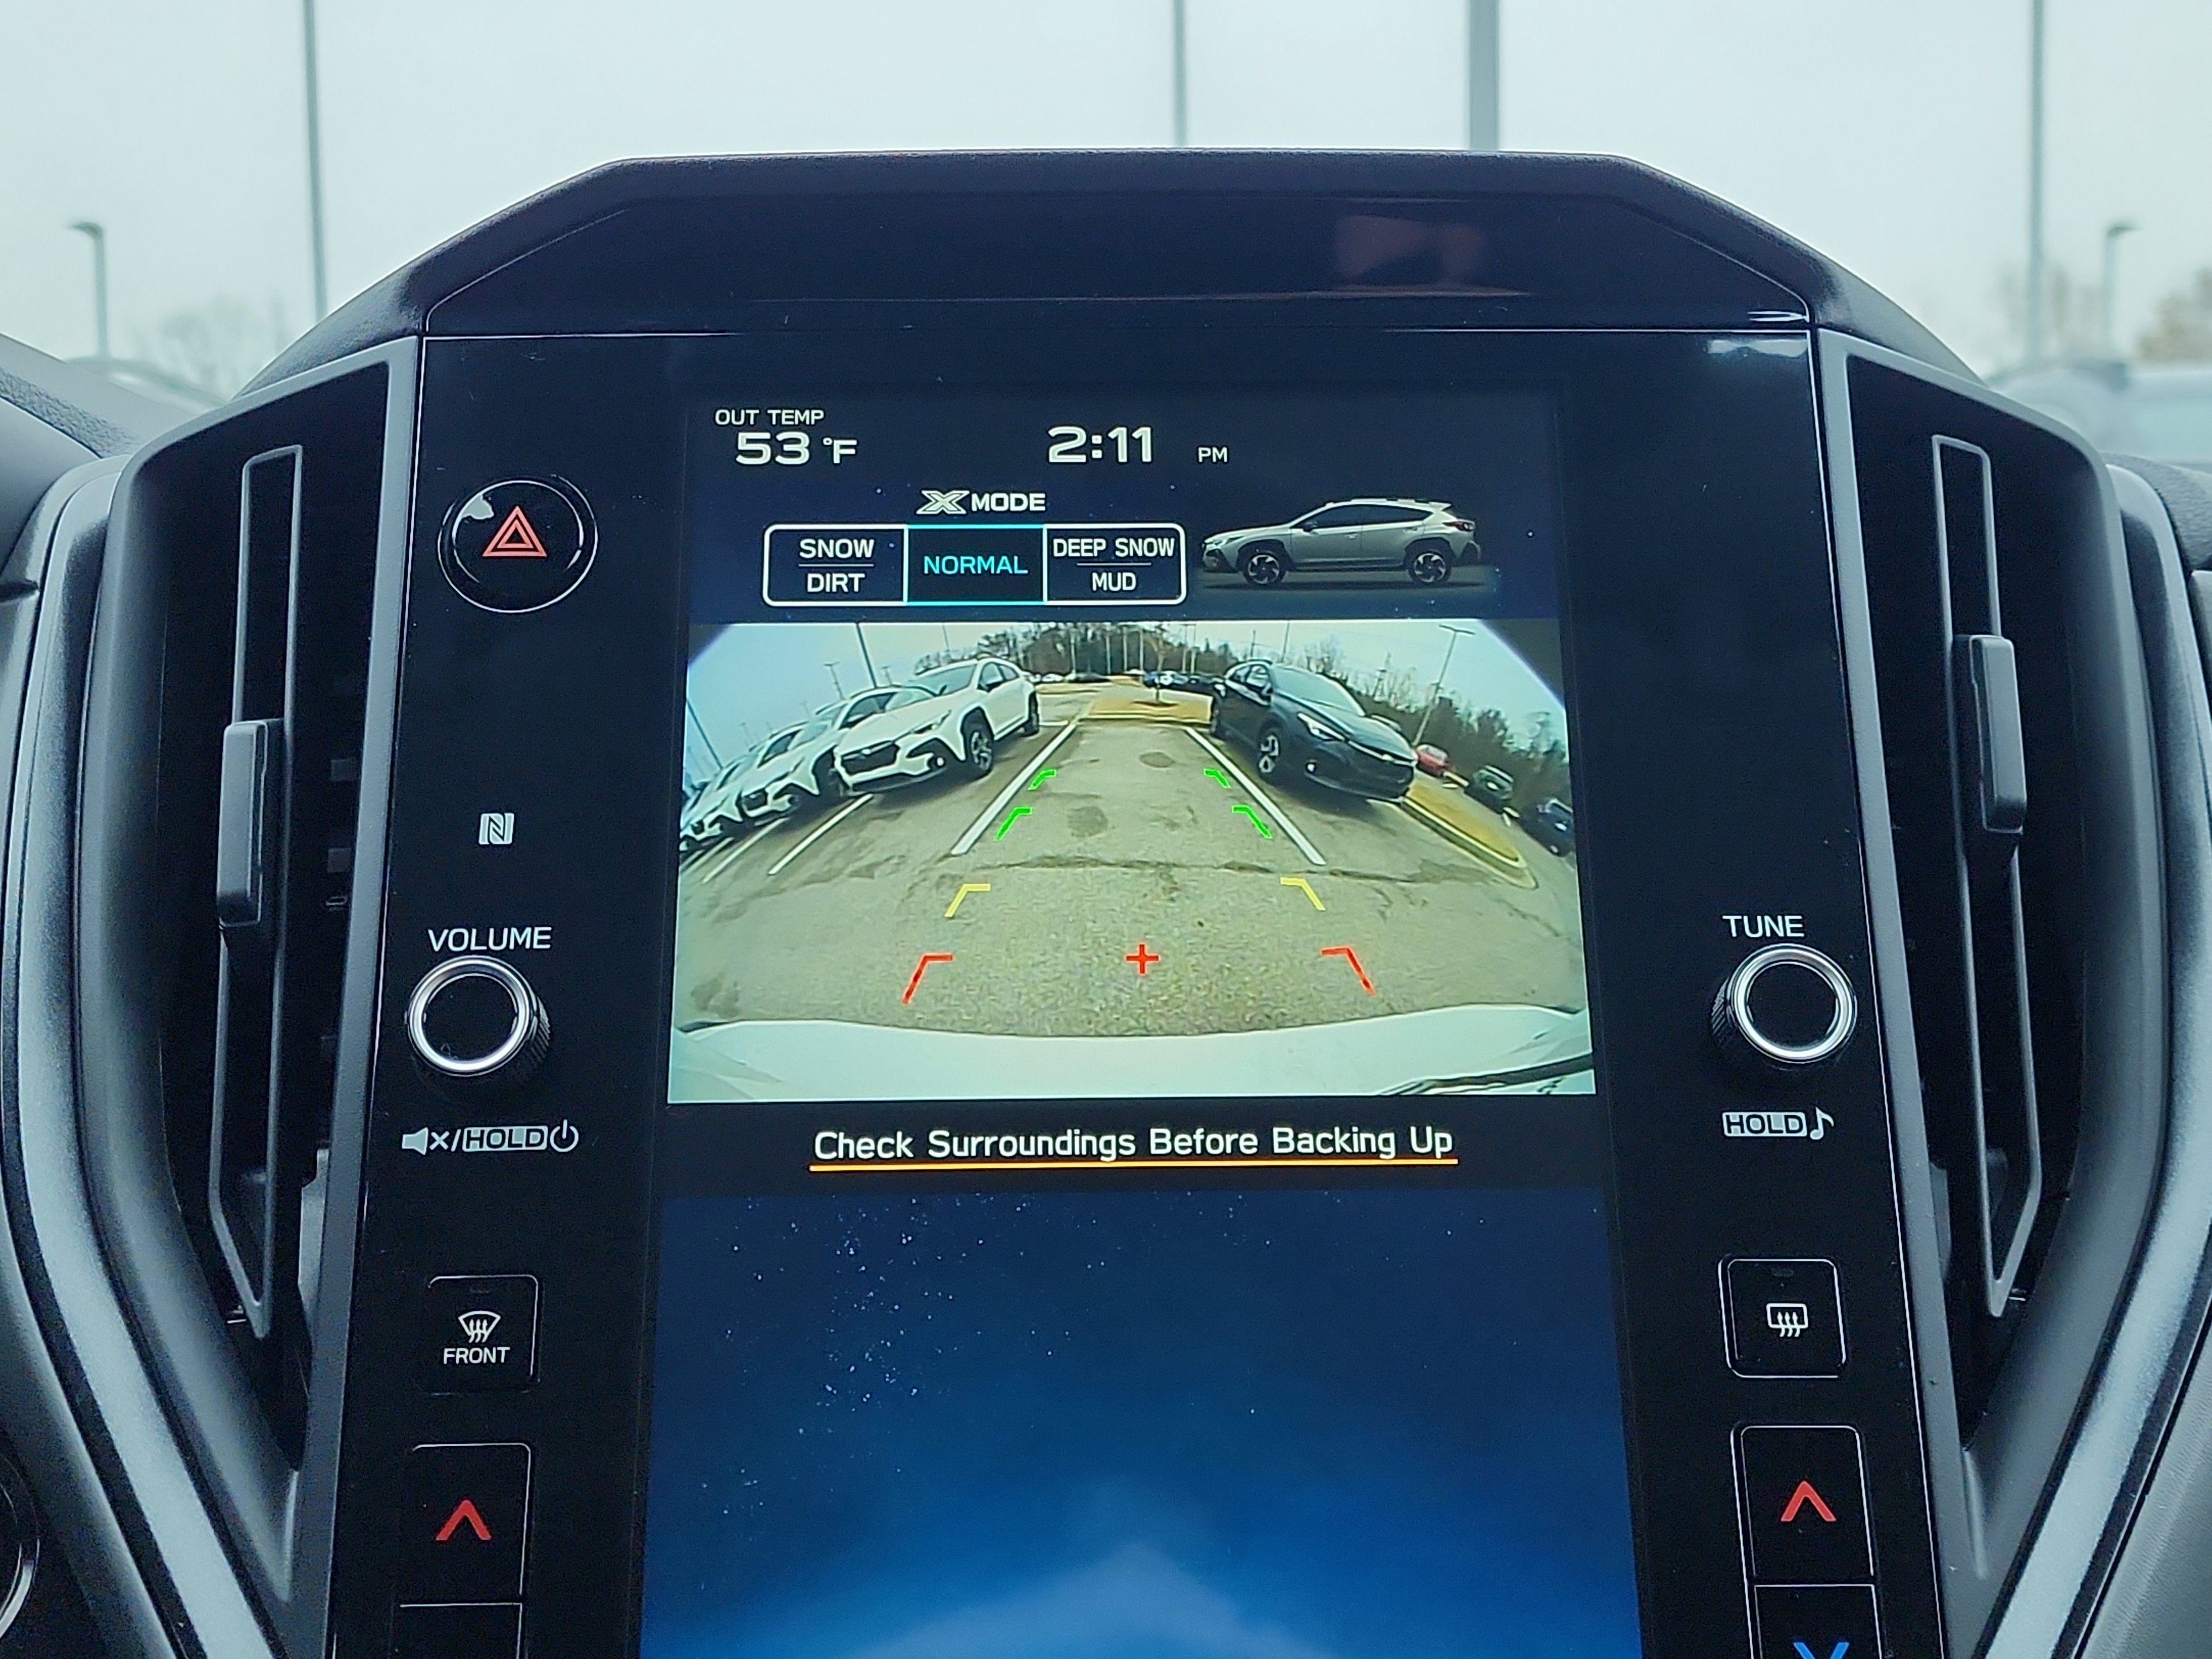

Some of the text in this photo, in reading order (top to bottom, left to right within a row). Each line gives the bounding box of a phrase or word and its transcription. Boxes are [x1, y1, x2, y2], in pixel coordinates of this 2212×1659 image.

[714, 409, 825, 425] OUT TEMP
[735, 431, 810, 465] 53
[1047, 426, 1152, 463] 2:11
[1197, 446, 1228, 463] PM
[799, 538, 875, 559] SNOW
[1052, 538, 1175, 557] DEEP SNOW
[923, 555, 1029, 575] NORMAL
[806, 572, 866, 593] DIRT
[1091, 572, 1137, 592] MUD
[1721, 915, 1806, 938] TUNE
[427, 926, 553, 952] VOLUME
[1724, 1113, 1805, 1135] HOLD
[814, 1125, 1453, 1162] Check Surroundings Before Backing Up
[443, 1346, 511, 1365] FRONT
